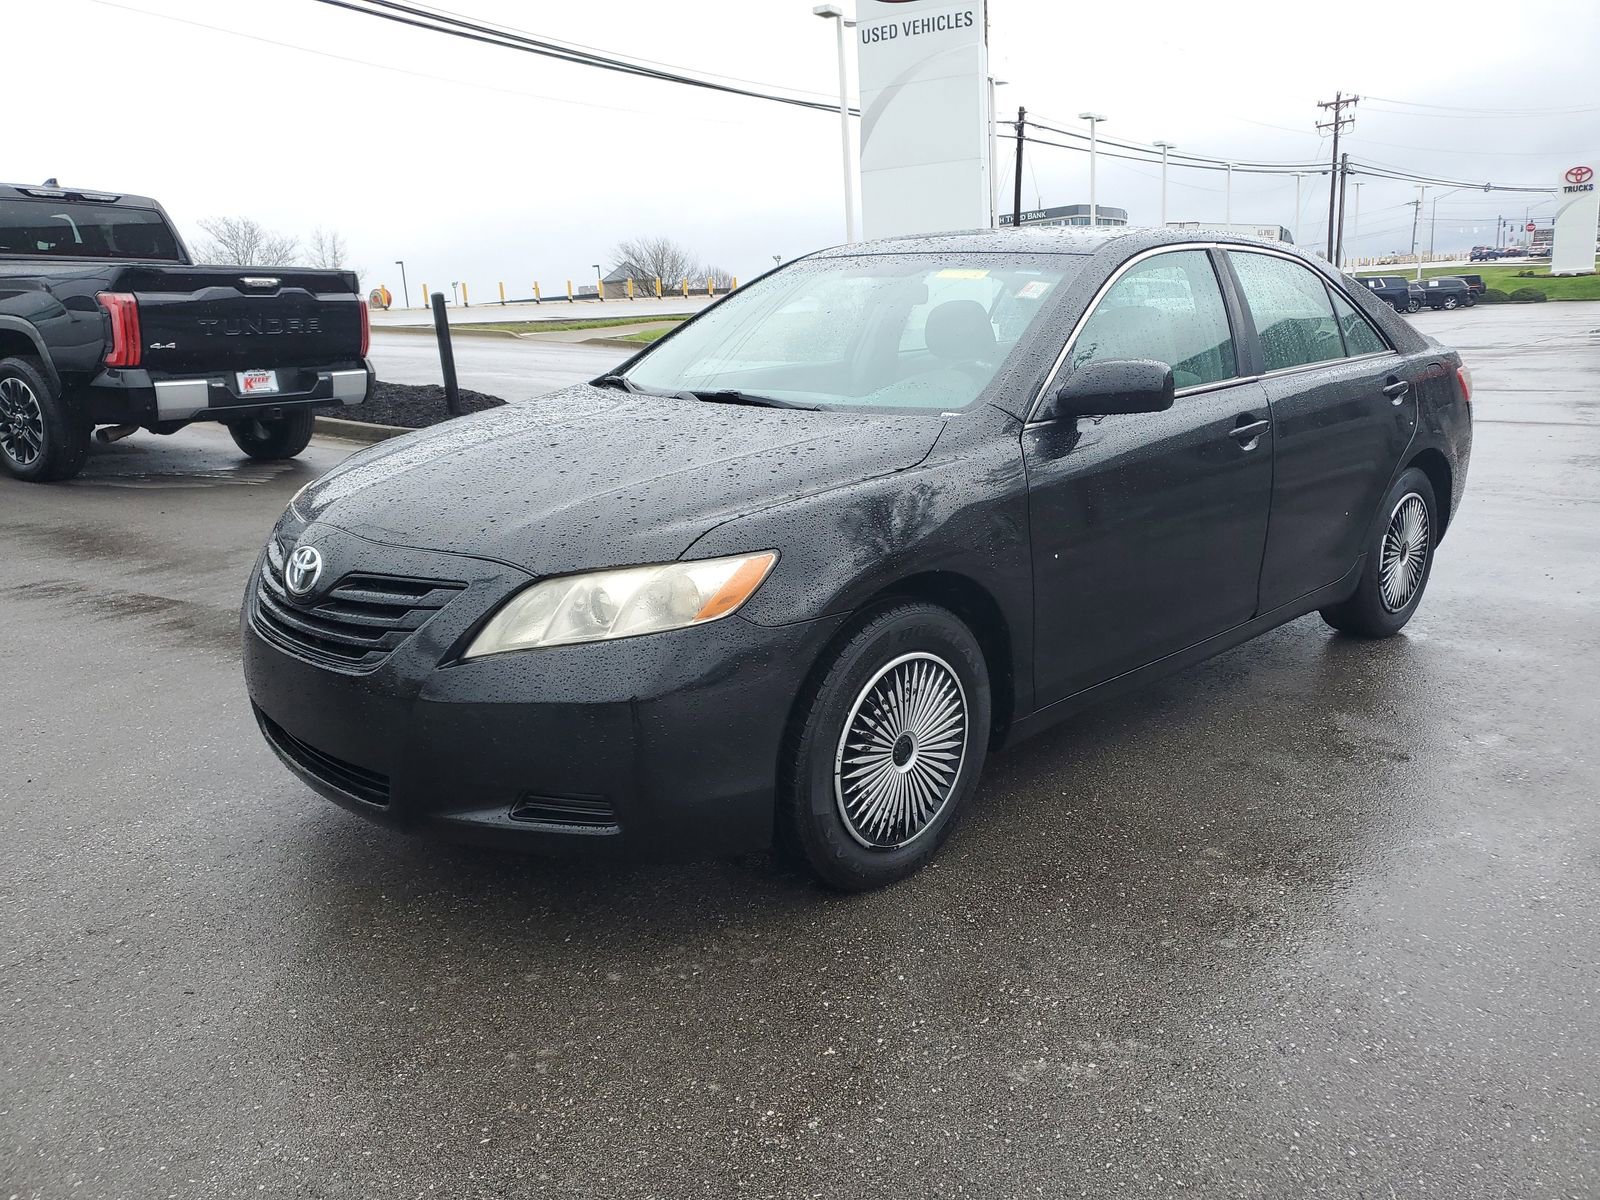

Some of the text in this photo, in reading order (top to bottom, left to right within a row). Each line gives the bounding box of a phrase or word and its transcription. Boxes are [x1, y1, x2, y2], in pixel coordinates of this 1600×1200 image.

[862, 11, 973, 44] USED VEHICLES
[1563, 184, 1594, 193] TRUCKS
[1027, 211, 1047, 220] BANK
[198, 318, 322, 336] TUNDRA
